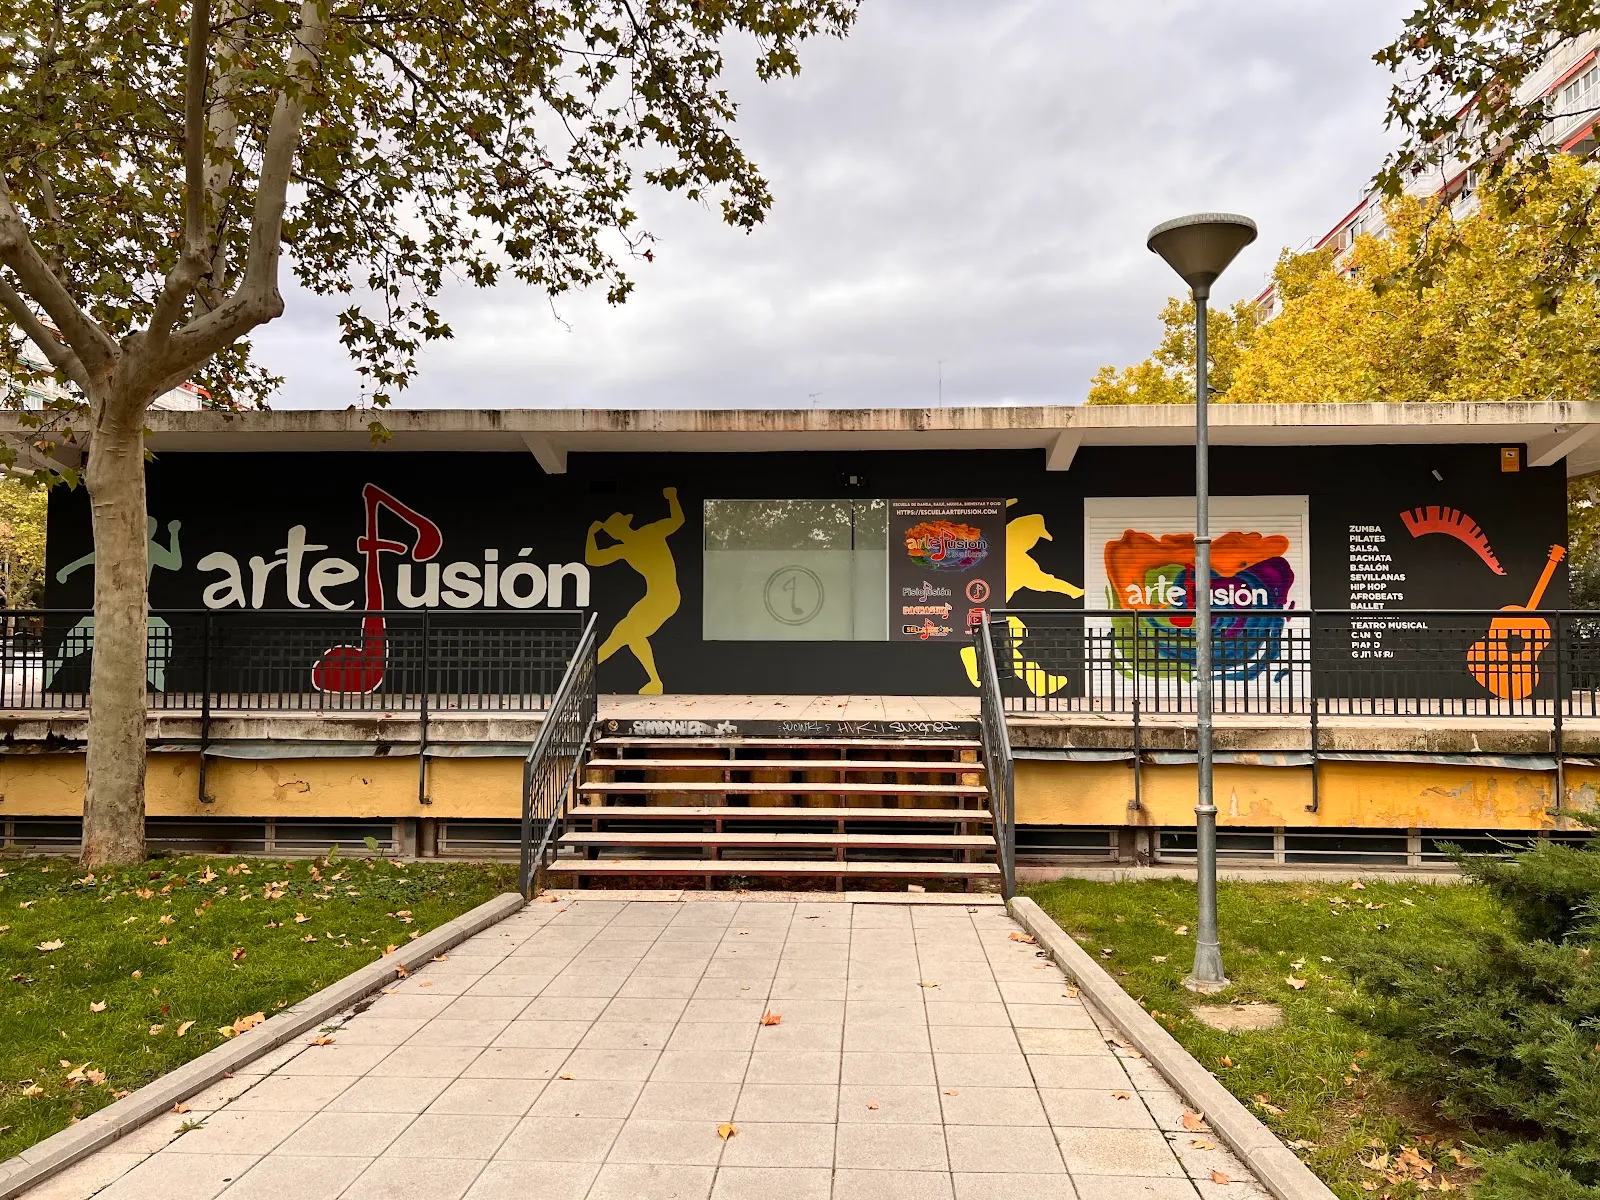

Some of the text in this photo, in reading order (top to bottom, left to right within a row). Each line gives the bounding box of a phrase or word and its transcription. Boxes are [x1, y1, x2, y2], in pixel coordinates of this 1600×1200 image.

[1349, 525, 1382, 533] ZUMBA
[1350, 554, 1392, 562] BACHATA
[1350, 563, 1389, 571] B.SALÓN
[1350, 573, 1406, 581] SEVILLANAS
[1350, 583, 1387, 591] HIP HOP
[1351, 602, 1385, 610] BALLET
[1351, 621, 1428, 629] TEATRO MUSICAL
